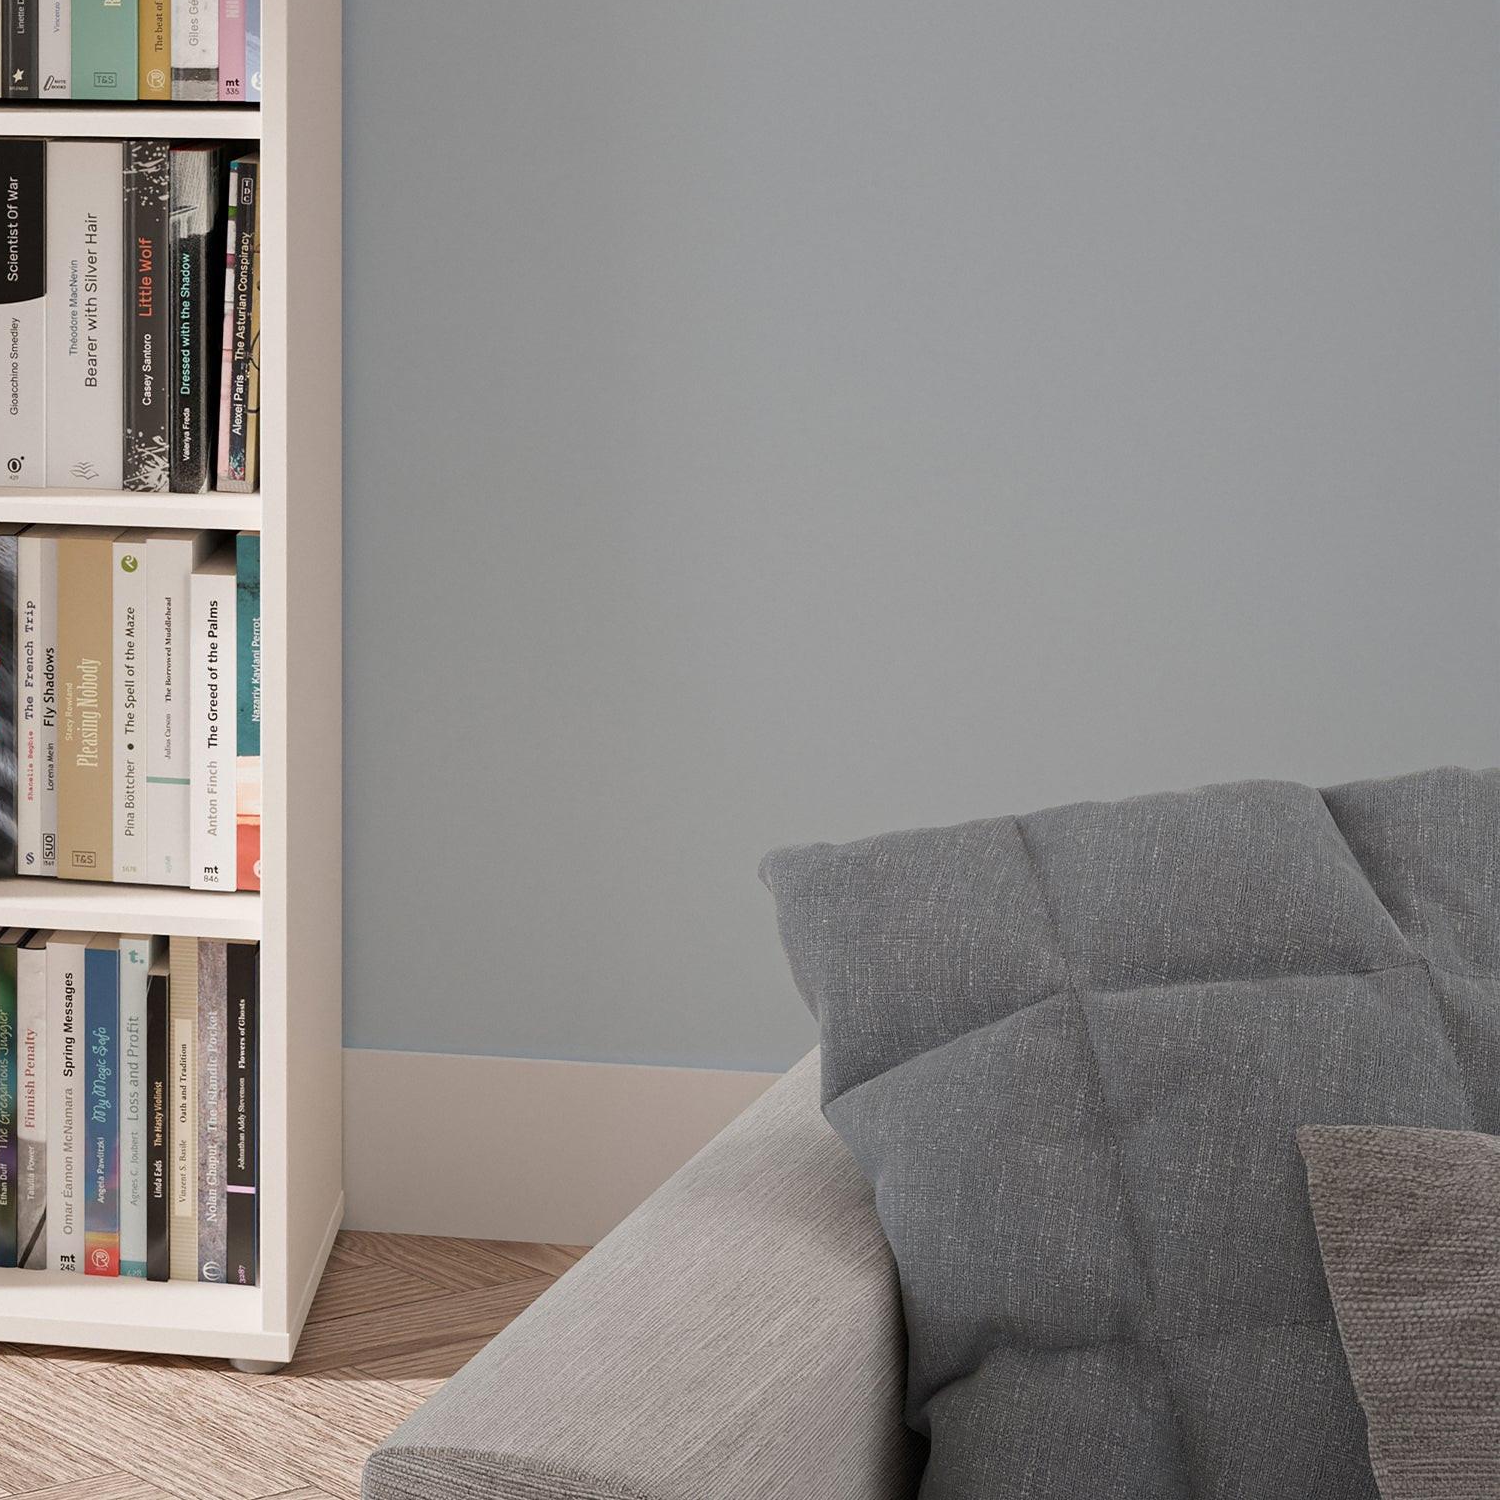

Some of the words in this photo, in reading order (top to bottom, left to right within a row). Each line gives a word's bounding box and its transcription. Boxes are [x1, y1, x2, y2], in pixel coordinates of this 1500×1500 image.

[189, 18, 199, 46] Giles
[8, 177, 18, 201] War
[7, 204, 18, 219] Of
[85, 213, 97, 244] Hair
[8, 223, 18, 281] Scientist
[139, 237, 152, 272] Wolf
[238, 232, 250, 291] Conspiracy
[85, 250, 97, 292] Silver
[139, 276, 152, 316] Little
[85, 297, 97, 331] with
[236, 294, 247, 339] Asturian
[10, 318, 20, 359] Smedley
[142, 334, 151, 371] Santoro
[235, 341, 244, 360] The
[85, 336, 97, 387] Bearer
[10, 362, 19, 415] Gioacchino
[143, 375, 153, 405] Casey
[234, 375, 244, 401] Paris
[233, 403, 242, 435] Alexei
[25, 601, 35, 632] Trip
[125, 607, 134, 637] Maze
[208, 601, 218, 638] Palms
[24, 641, 33, 687] French
[125, 641, 134, 660] the
[209, 642, 218, 663] the
[44, 648, 54, 703] Shadows
[77, 659, 99, 707] Nobody
[125, 664, 134, 676] of
[208, 667, 218, 680] of
[25, 696, 33, 719] The
[125, 680, 137, 709] Spell
[208, 684, 218, 721] Greed
[44, 707, 56, 727] Fly
[125, 713, 134, 734] The
[77, 712, 99, 766] Pleasing
[209, 726, 218, 748] The
[125, 760, 135, 809] Böttcher
[208, 761, 217, 794] Finch
[125, 812, 134, 836] Pina
[208, 800, 217, 836] Anton
[45, 836, 53, 857] SUO
[63, 973, 75, 1032] Messages
[127, 1017, 138, 1057] Profit
[63, 1037, 75, 1077] Spring
[128, 1063, 138, 1086] and
[64, 1088, 73, 1152] McNamara
[128, 1092, 139, 1120] Loss
[61, 1157, 72, 1197] Éamon
[64, 1202, 72, 1235] Omar
[61, 1263, 75, 1271] 245
